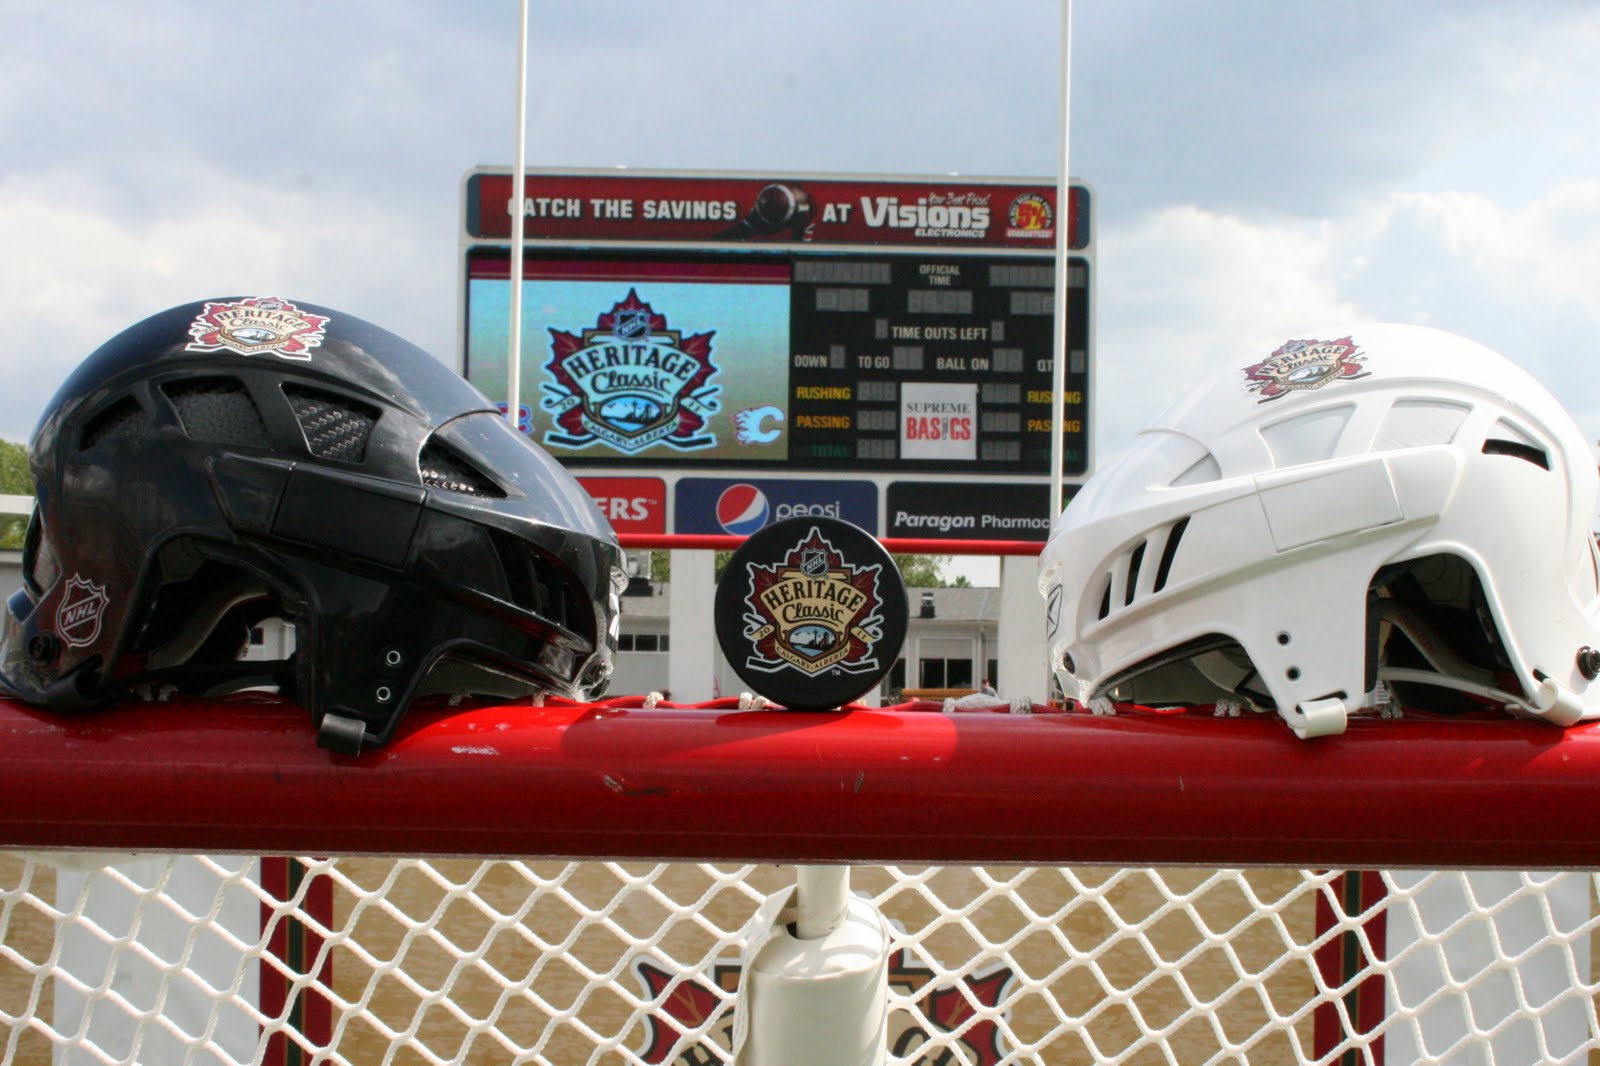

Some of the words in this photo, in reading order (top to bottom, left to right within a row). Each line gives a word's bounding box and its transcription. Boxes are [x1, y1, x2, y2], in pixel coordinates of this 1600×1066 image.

[590, 199, 633, 218] THE
[643, 200, 737, 220] SAVINGS
[822, 203, 852, 223] AT
[860, 196, 990, 229] Visions
[914, 228, 986, 238] ELECTRONICS
[919, 264, 961, 275] OFFICIAL
[929, 275, 952, 286] TIME
[215, 309, 308, 330] HERITAGE
[229, 318, 289, 332] Classic
[892, 326, 921, 340] TIME
[924, 327, 957, 340] OUTS
[960, 328, 988, 341] LEFT
[567, 345, 697, 381] HERITAGE
[794, 355, 828, 369] DOWN
[858, 356, 873, 369] TO
[874, 356, 890, 369] GO
[936, 357, 967, 371] BALL
[971, 358, 989, 371] ON
[1037, 359, 1054, 373] QT
[1259, 345, 1346, 375] HERITAGE
[1276, 354, 1332, 375] Classic
[591, 370, 672, 396] Classic
[796, 386, 852, 400] RUSHING
[1027, 390, 1082, 405] RUSNG
[906, 402, 971, 414] SUPREME
[796, 415, 850, 429] PASSING
[1027, 419, 1081, 433] PASNG
[591, 497, 650, 521] ERS
[775, 501, 841, 522] pepsi
[894, 511, 976, 532] Paragon
[981, 514, 1051, 529] Pharmac
[806, 556, 824, 571] NHL
[764, 580, 864, 612] HERITAGE
[63, 601, 97, 626] NHL
[782, 603, 844, 625] Classic
[759, 626, 771, 638] 20
[856, 630, 867, 640] 11
[814, 648, 849, 670] ALBERTA
